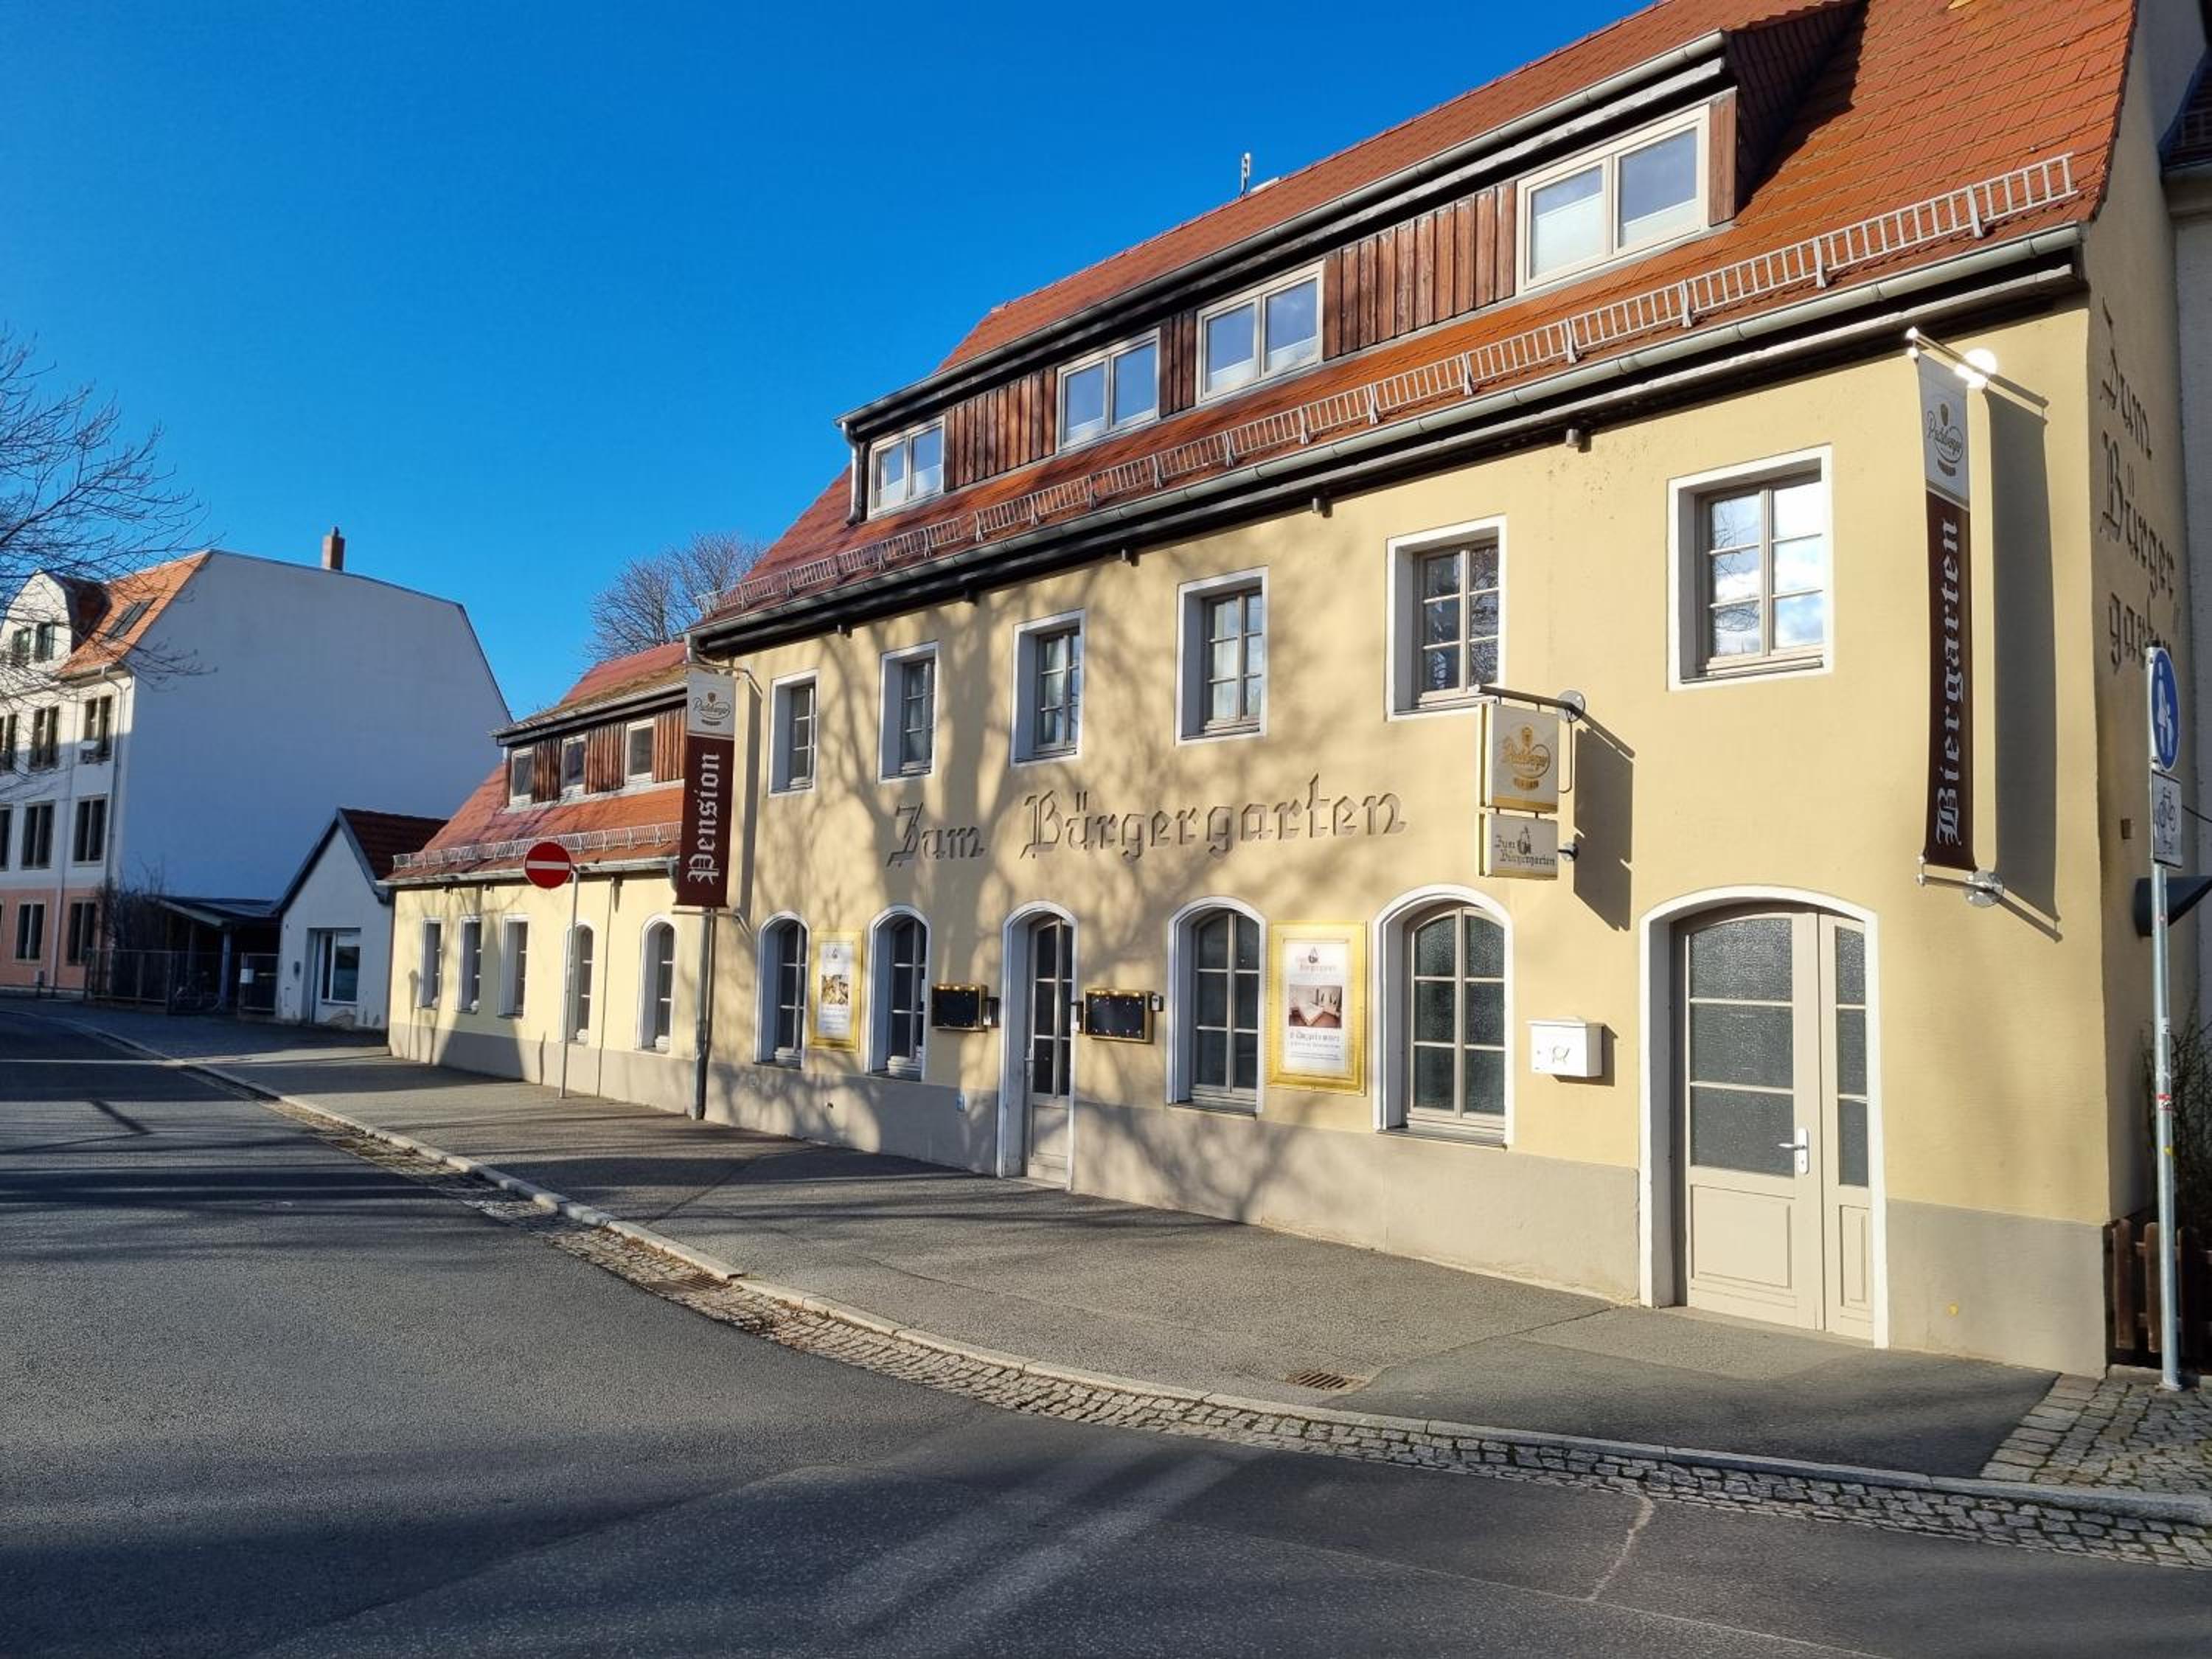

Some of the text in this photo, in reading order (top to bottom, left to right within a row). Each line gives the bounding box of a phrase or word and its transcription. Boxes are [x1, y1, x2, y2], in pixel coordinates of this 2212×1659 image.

[2099, 296, 2152, 460] Zum
[1936, 518, 1964, 846] Biergarten
[687, 754, 720, 886] Pension
[886, 773, 1407, 868] Zum Bürgergarten
